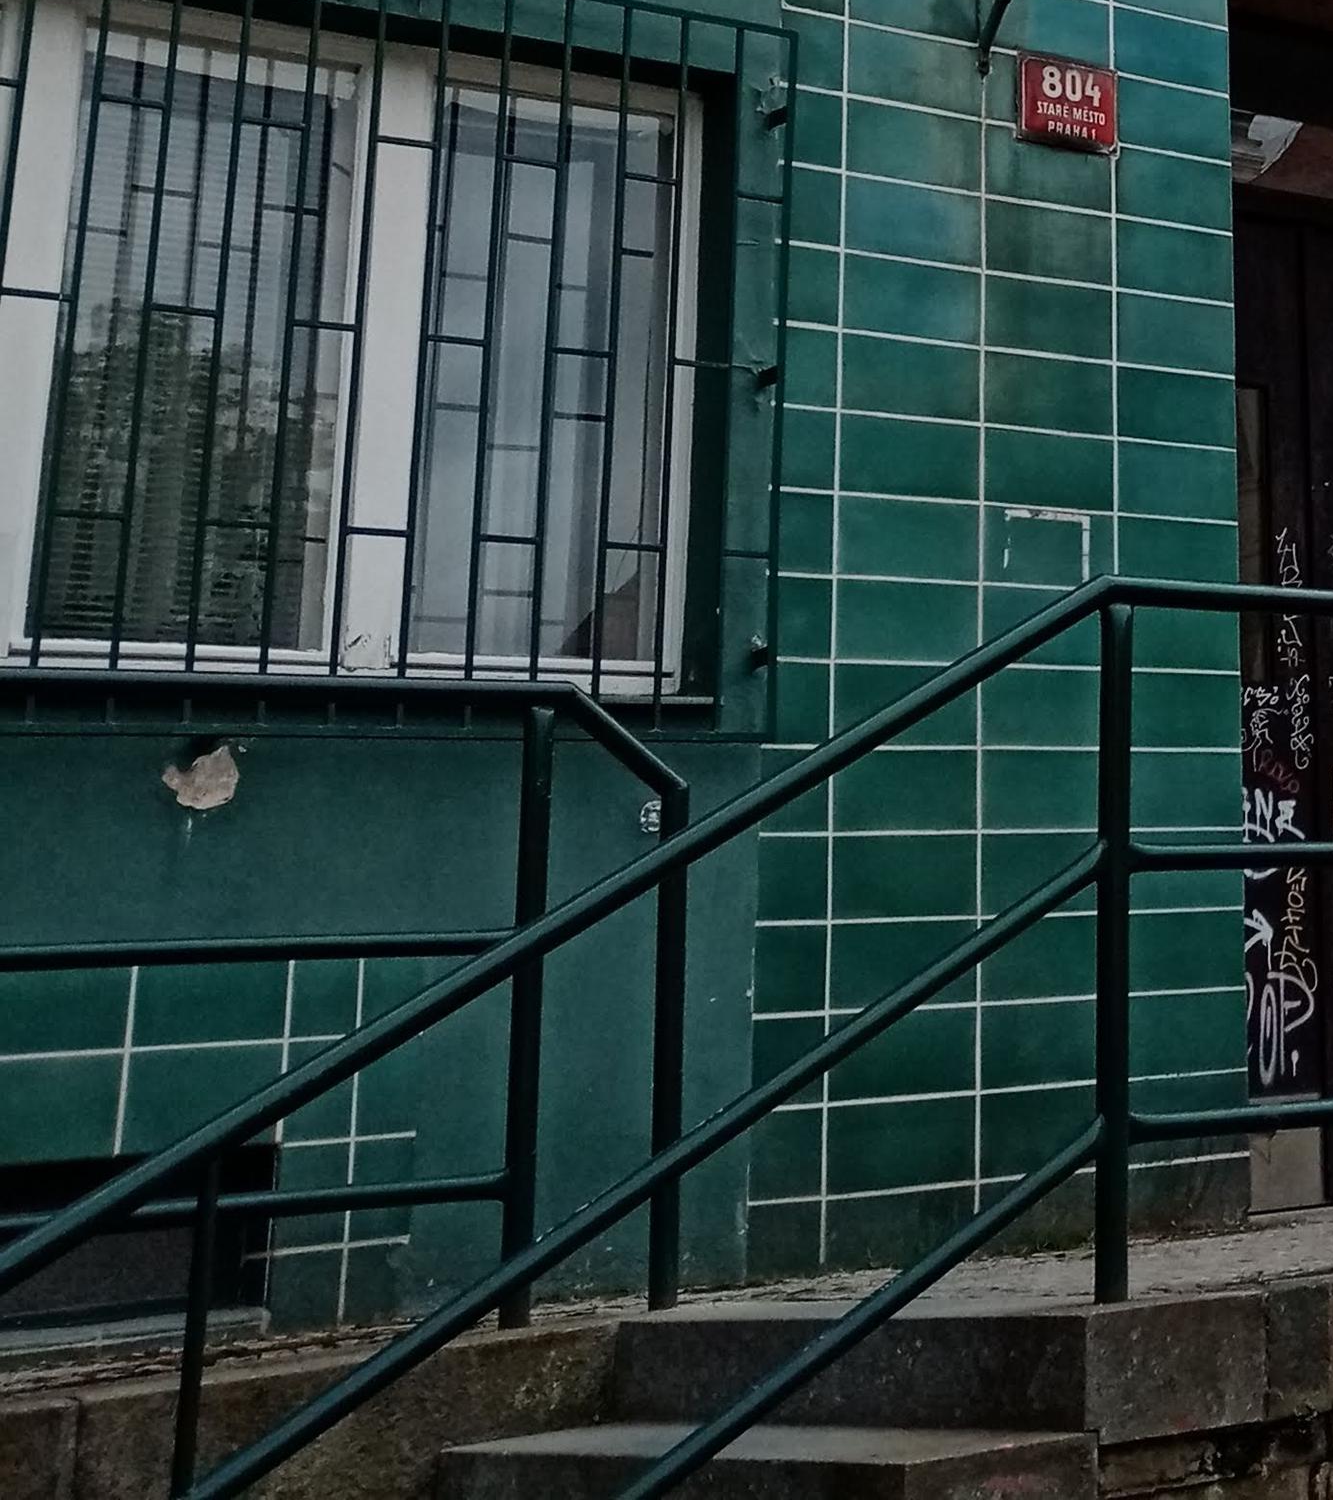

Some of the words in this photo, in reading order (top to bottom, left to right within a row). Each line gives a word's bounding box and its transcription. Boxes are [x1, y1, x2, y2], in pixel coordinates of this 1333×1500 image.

[1042, 65, 1101, 108] 804
[1037, 100, 1069, 118] STARÉ
[1073, 106, 1105, 126] MĚSTO
[1047, 120, 1088, 139] PRAHA
